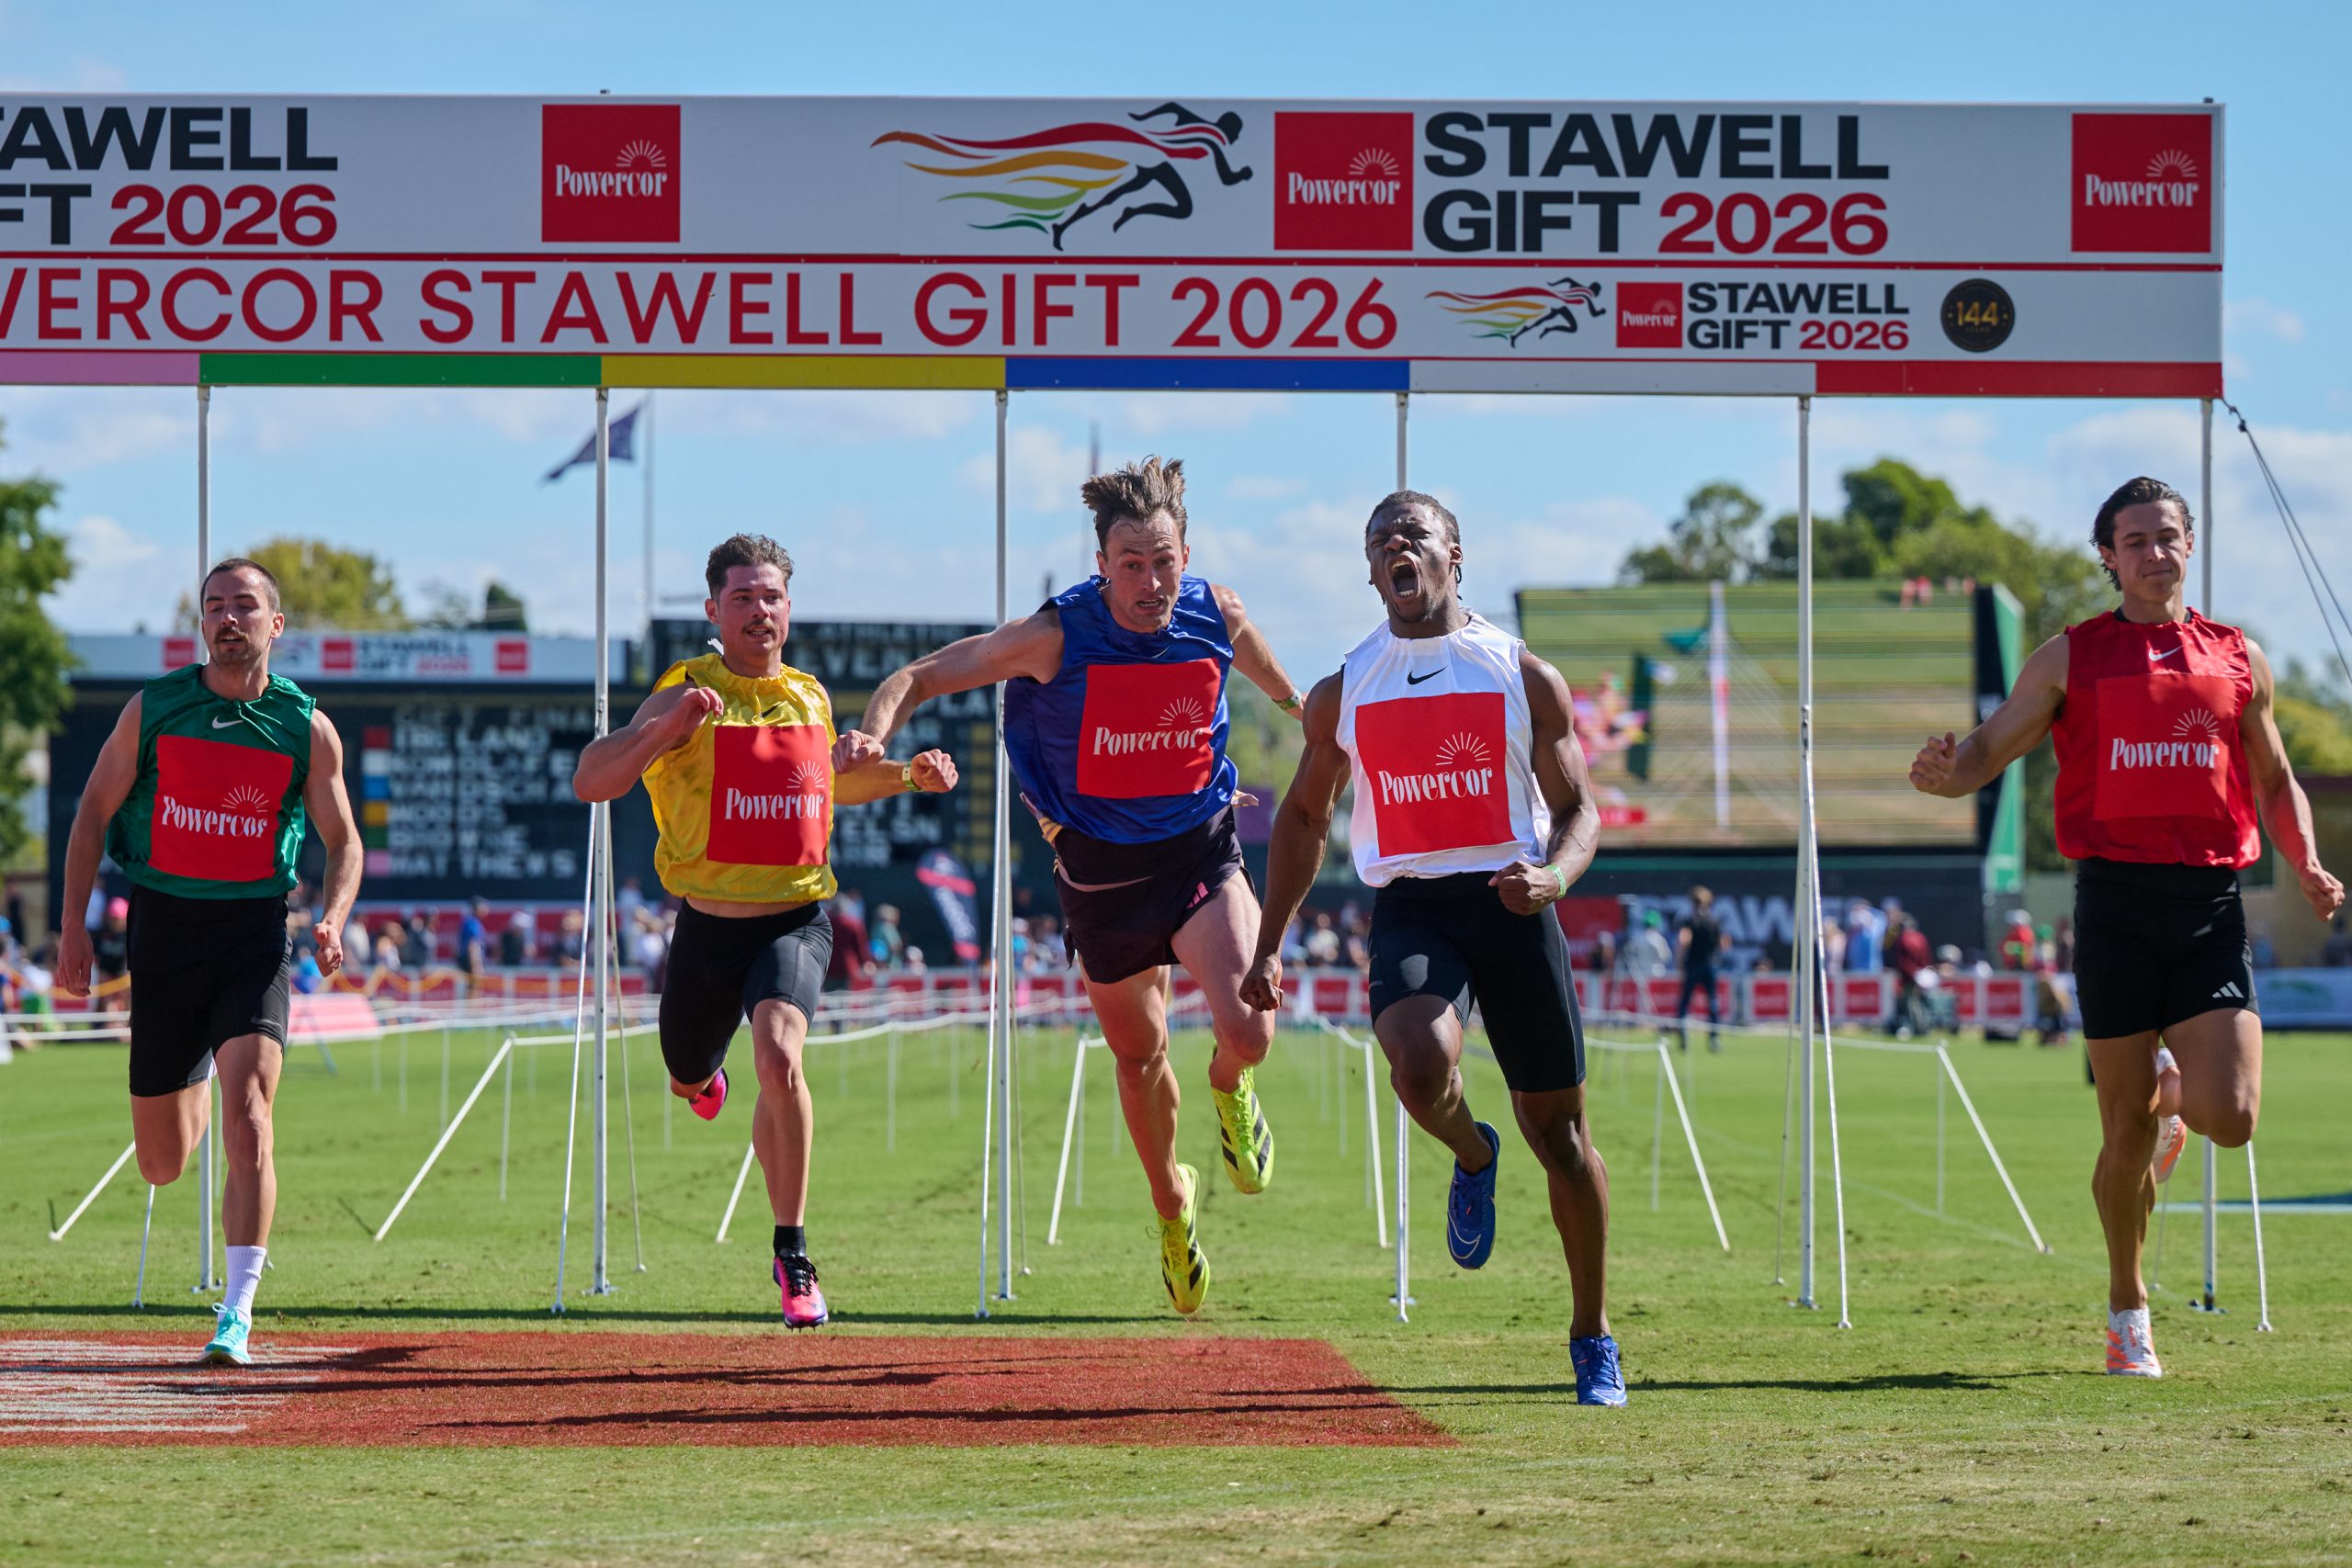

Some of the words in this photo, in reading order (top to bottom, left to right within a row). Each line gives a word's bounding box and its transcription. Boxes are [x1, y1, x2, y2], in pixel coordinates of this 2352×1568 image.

[0, 107, 338, 171] AWELL
[1424, 112, 1889, 180] STAWELL
[555, 164, 668, 197] Powercor
[1287, 172, 1401, 205] Powercor
[2084, 174, 2199, 208] Powercor
[110, 184, 337, 246] 2026
[1423, 189, 1640, 254] GIFT
[1658, 193, 1889, 255] 2026
[0, 267, 384, 342] ERCOR
[419, 269, 883, 344] STAWELL
[914, 272, 1140, 347] GIFT
[1171, 276, 1397, 349] 2026
[1687, 282, 1910, 314] STAWELL
[1956, 300, 1998, 326] 144
[1622, 310, 1677, 327] Powercor
[1687, 319, 1791, 350] GIFT
[1799, 320, 1909, 351] 2026
[1092, 725, 1204, 757] Powercor
[2109, 736, 2221, 771] Powercor
[1377, 765, 1494, 806] Powercor
[161, 795, 267, 839] Powercor
[723, 787, 825, 821] Powercor
